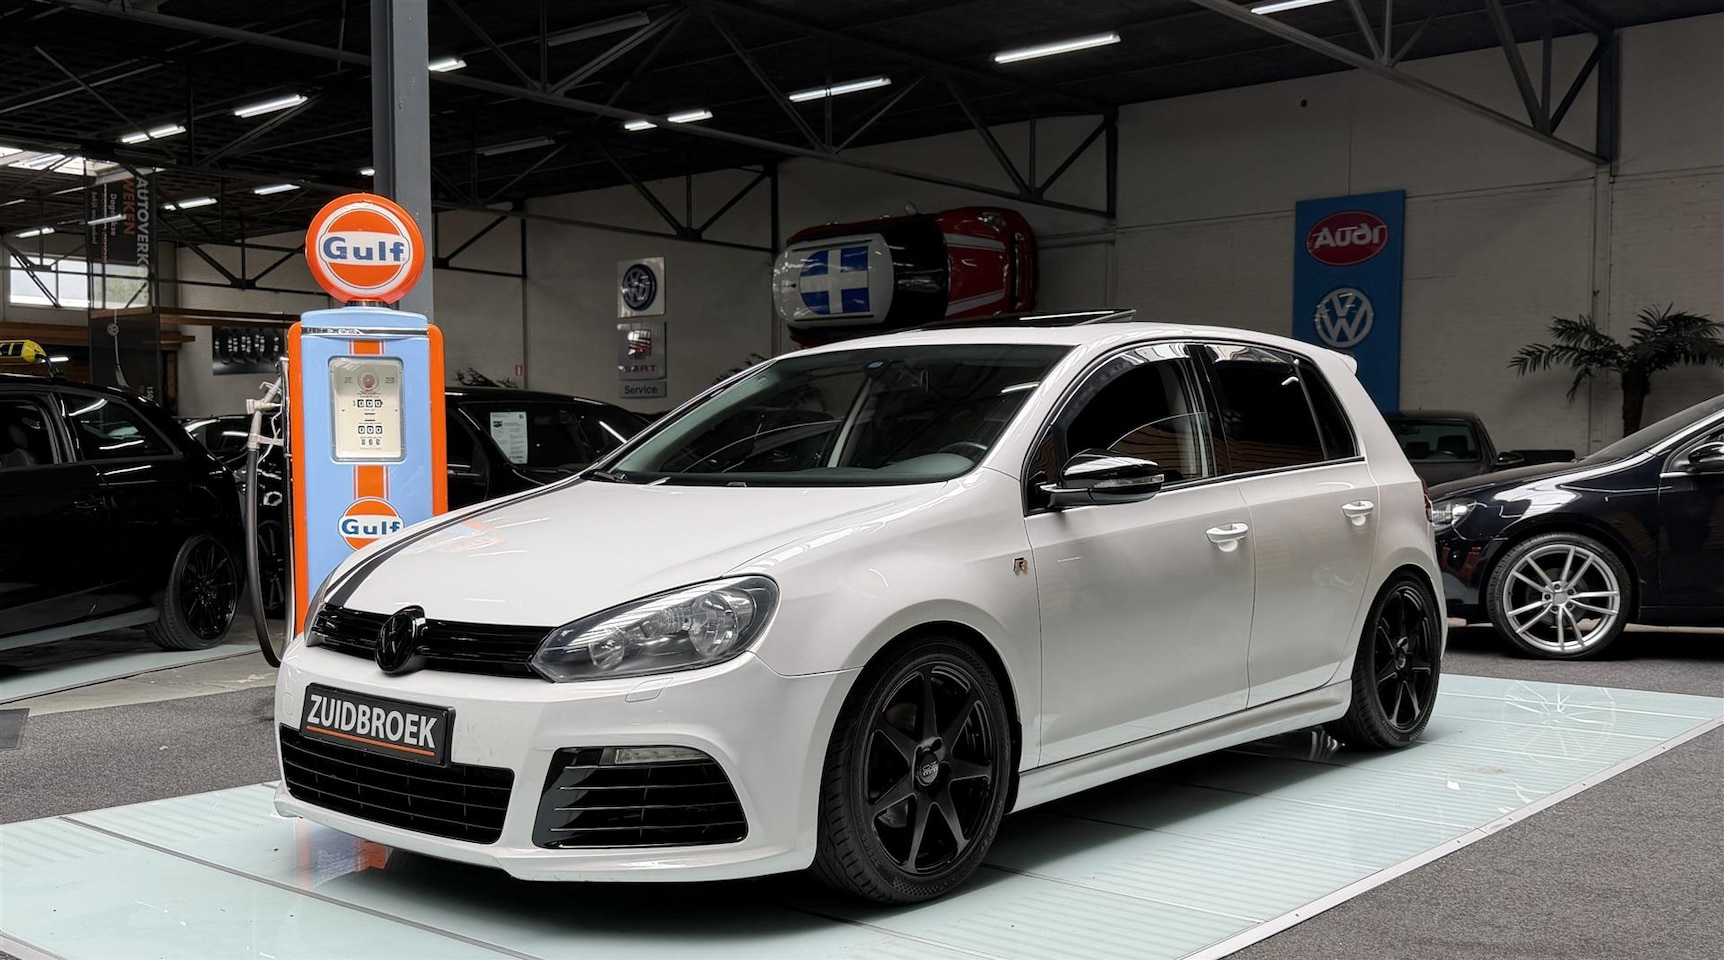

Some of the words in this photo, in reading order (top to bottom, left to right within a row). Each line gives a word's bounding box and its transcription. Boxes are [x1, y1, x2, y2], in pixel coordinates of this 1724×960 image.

[323, 236, 405, 262] Gulf
[1314, 223, 1380, 249] Audi
[624, 384, 658, 395] Service
[341, 518, 400, 535] Gulf
[306, 694, 437, 749] ZUIDBROEK
